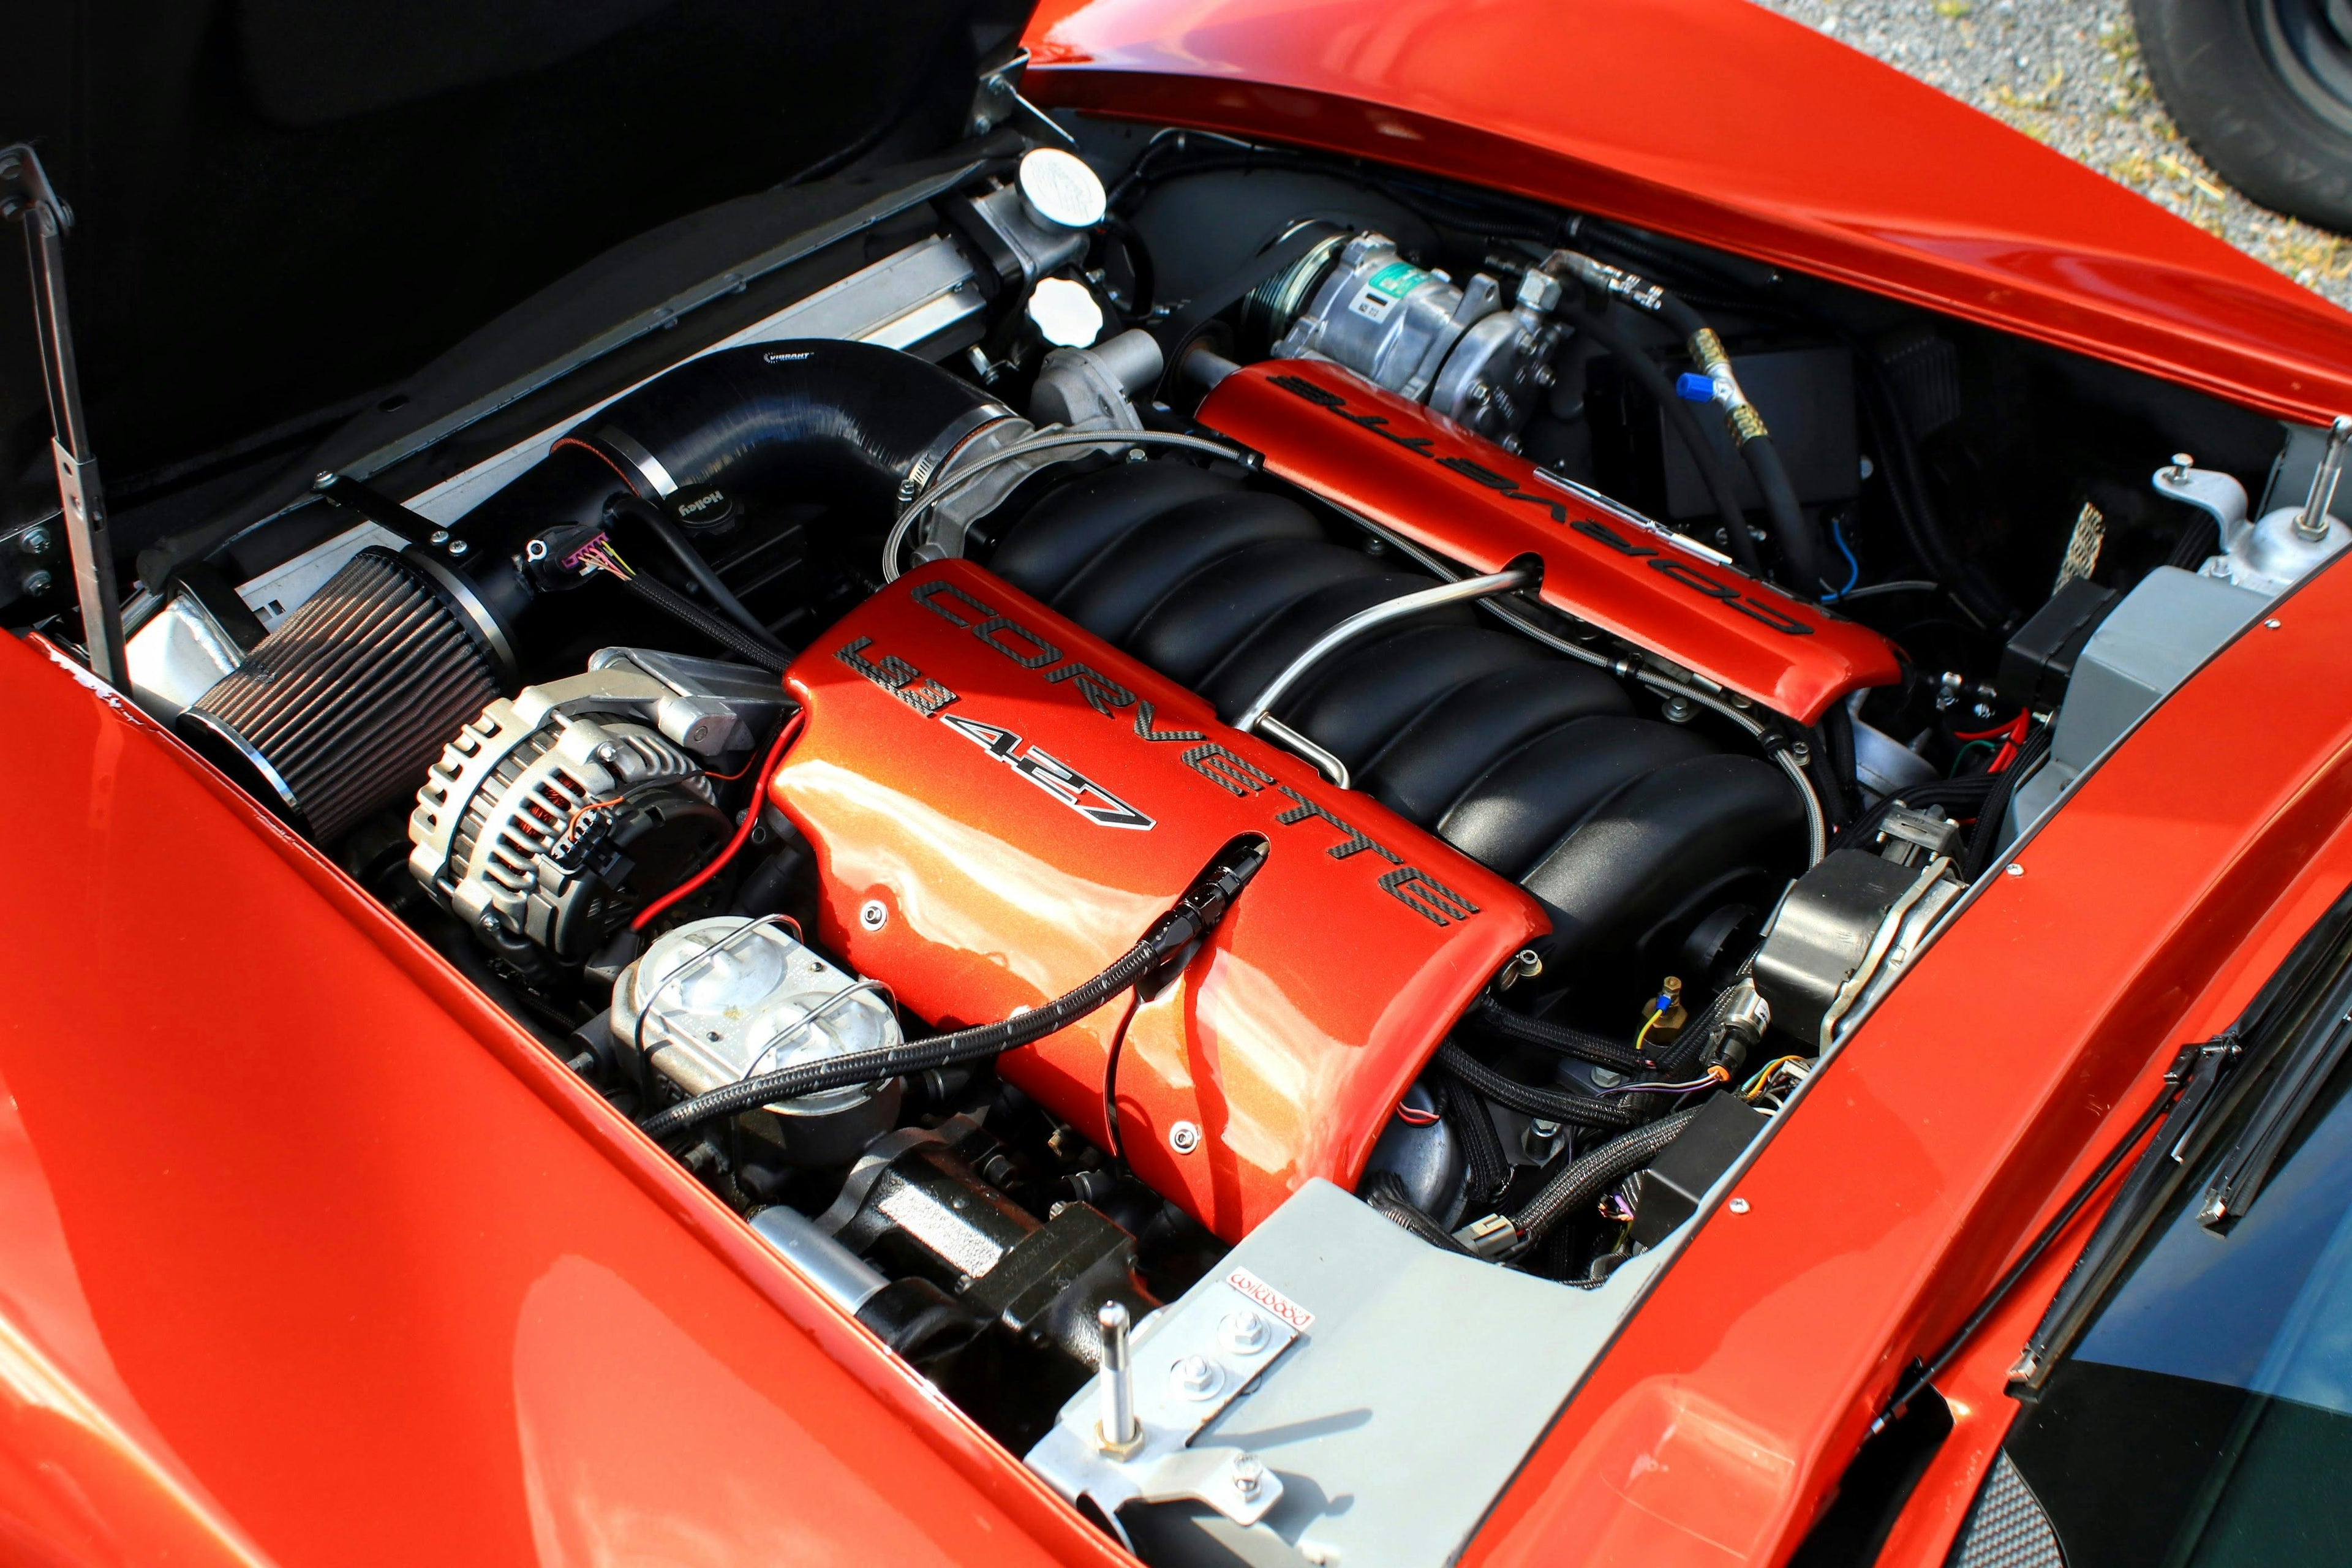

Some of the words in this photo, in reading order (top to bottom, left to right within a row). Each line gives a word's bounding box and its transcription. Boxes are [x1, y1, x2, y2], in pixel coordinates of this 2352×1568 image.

[770, 352, 810, 361] VIBRANT
[678, 490, 724, 516] Holley
[1266, 375, 1815, 635] CORVETTE
[833, 636, 957, 718] LS3
[911, 581, 1480, 927] CORVETTE
[939, 713, 1157, 831] 427
